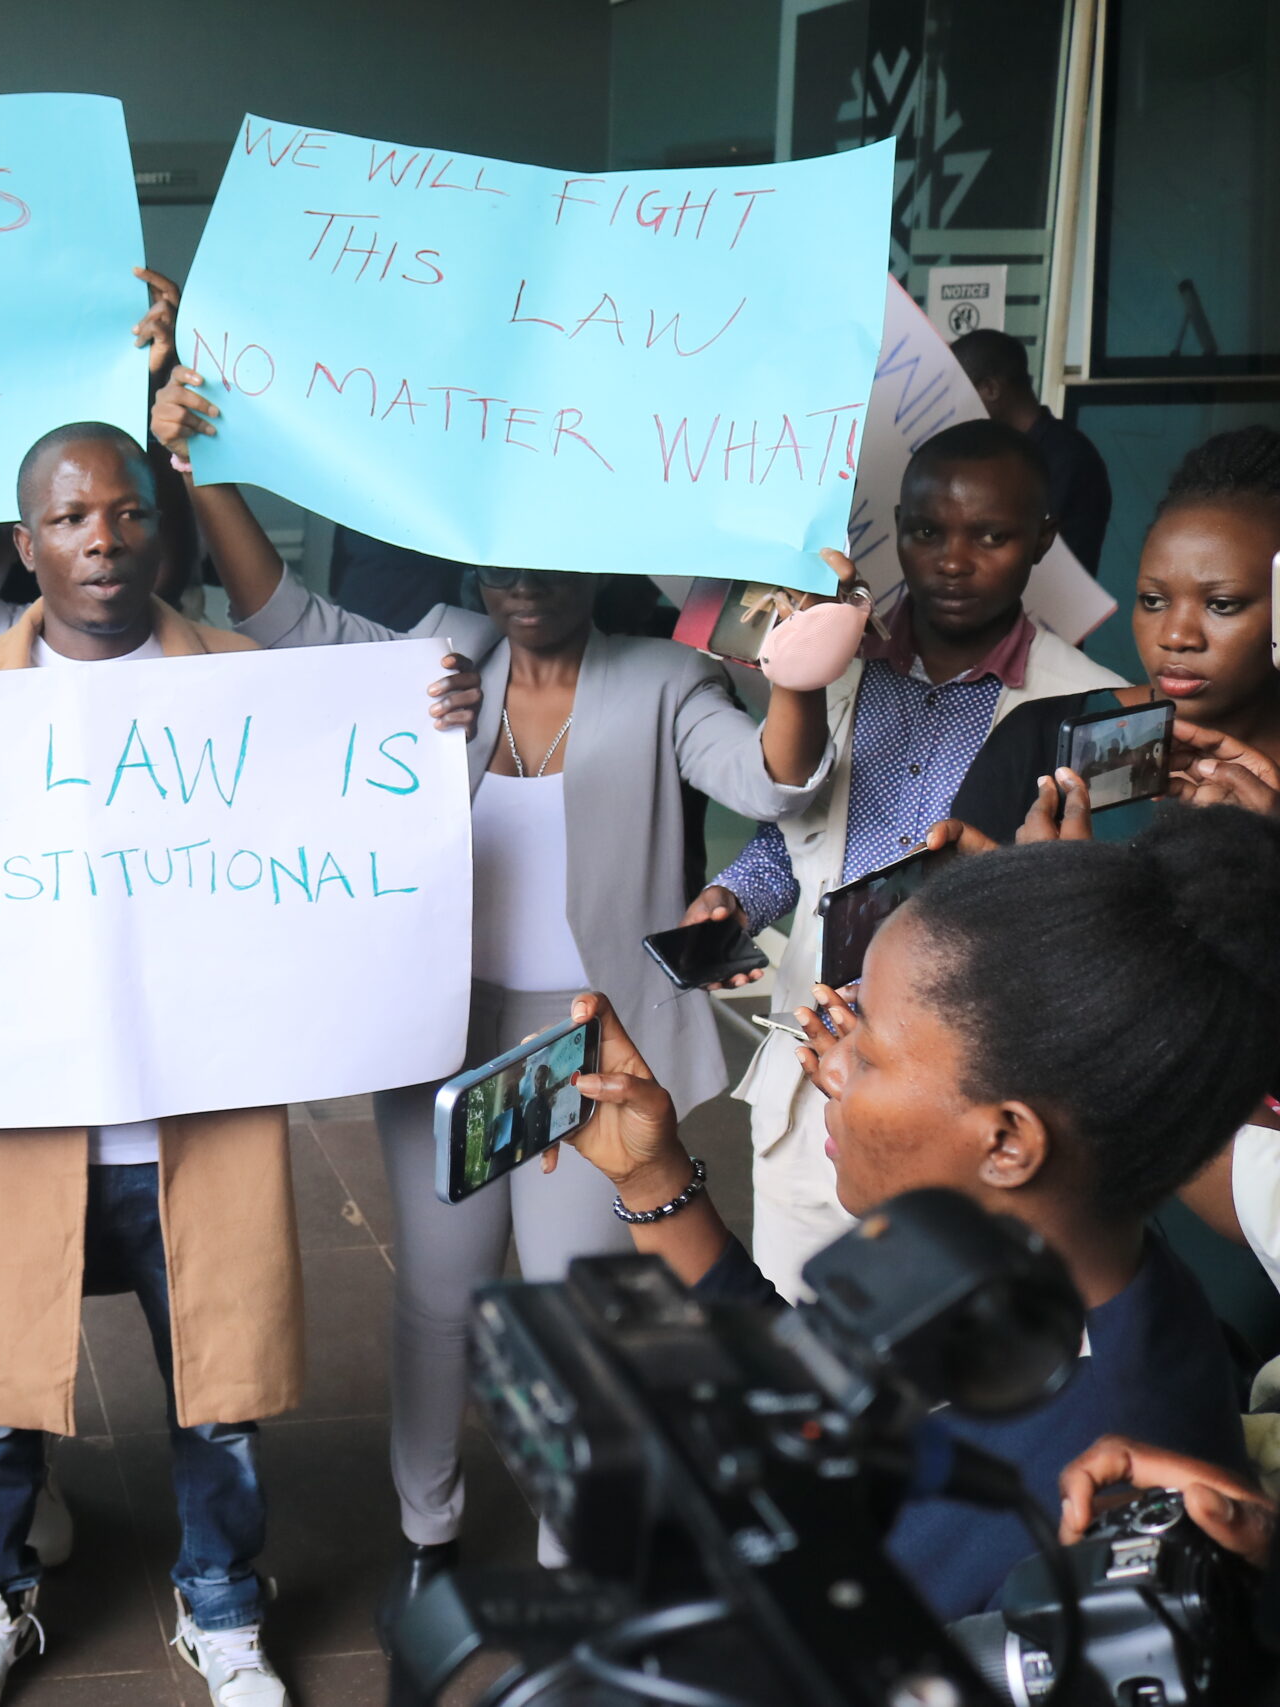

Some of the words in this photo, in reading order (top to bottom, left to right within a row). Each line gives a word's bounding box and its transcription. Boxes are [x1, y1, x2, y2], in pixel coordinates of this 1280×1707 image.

[244, 119, 336, 170] WE
[367, 149, 510, 197] WILL
[553, 178, 777, 250] FIGHT
[304, 210, 445, 285] THIS
[508, 279, 747, 357] LAW
[943, 285, 989, 299] NOTICE
[192, 328, 275, 397] NO
[306, 362, 615, 473] MATTER
[652, 403, 866, 486] WHAT!
[46, 716, 253, 808] LAW
[341, 723, 420, 797] IS
